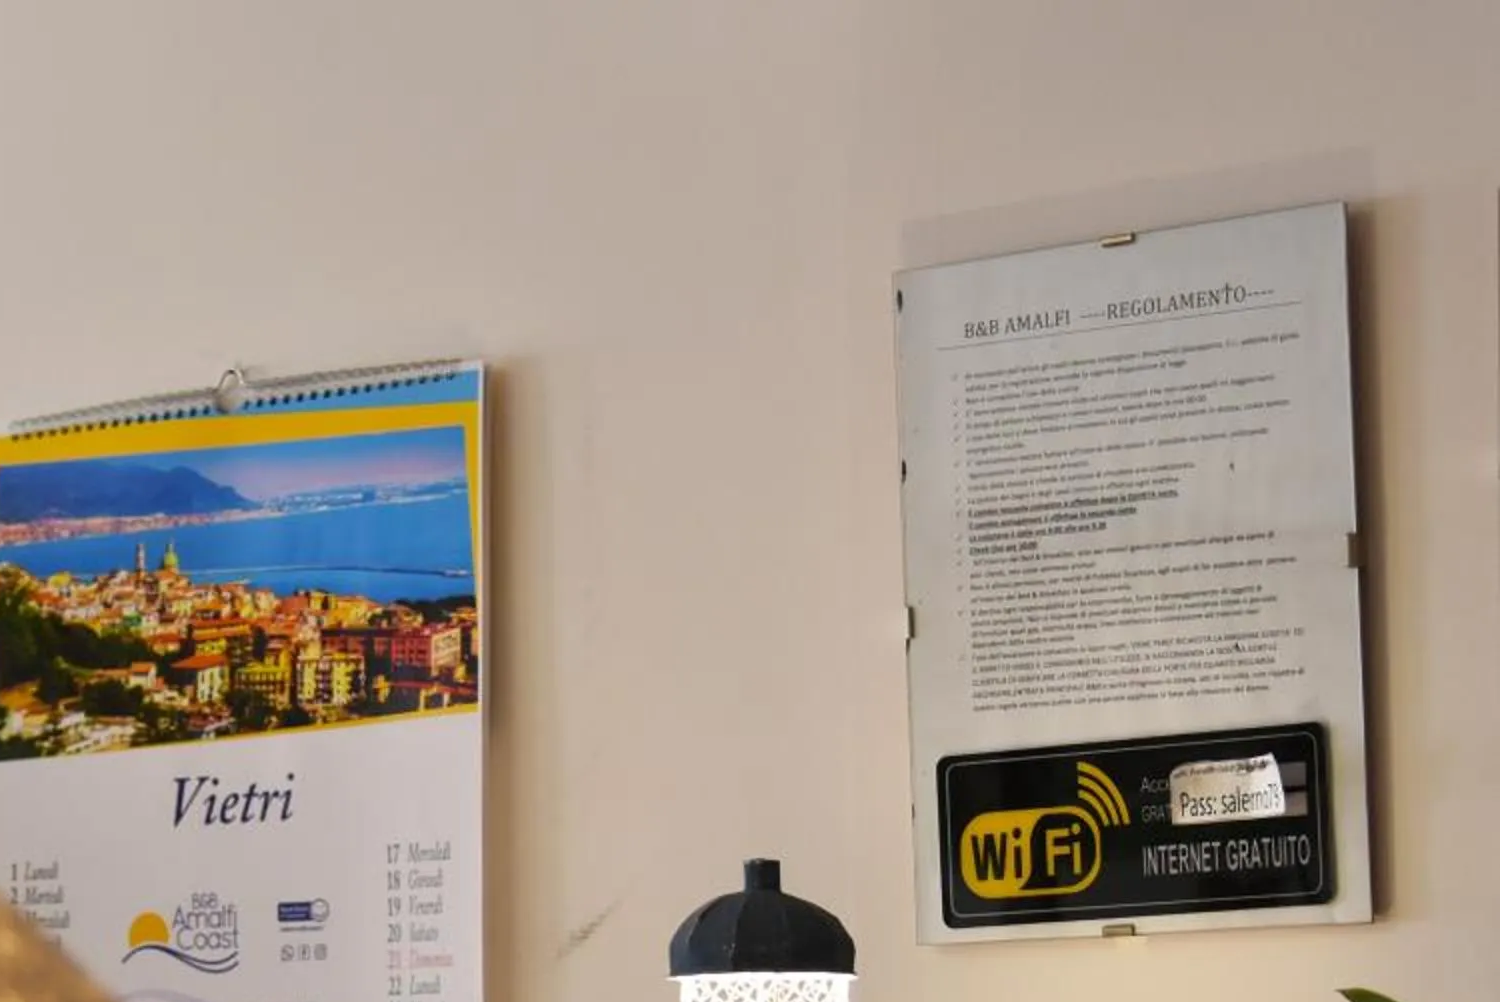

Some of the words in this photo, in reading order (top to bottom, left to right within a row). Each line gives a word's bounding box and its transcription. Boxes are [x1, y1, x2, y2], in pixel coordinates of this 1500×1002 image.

[964, 319, 999, 339] B&B
[1004, 309, 1072, 335] AMALFI
[173, 772, 295, 828] Vietri
[1180, 791, 1217, 817] Pass:
[386, 843, 400, 864] 17
[1142, 841, 1221, 876] INTERNET
[1226, 834, 1311, 872] GRATUITO
[172, 904, 238, 930] Amalfi
[176, 927, 239, 951] Coast
